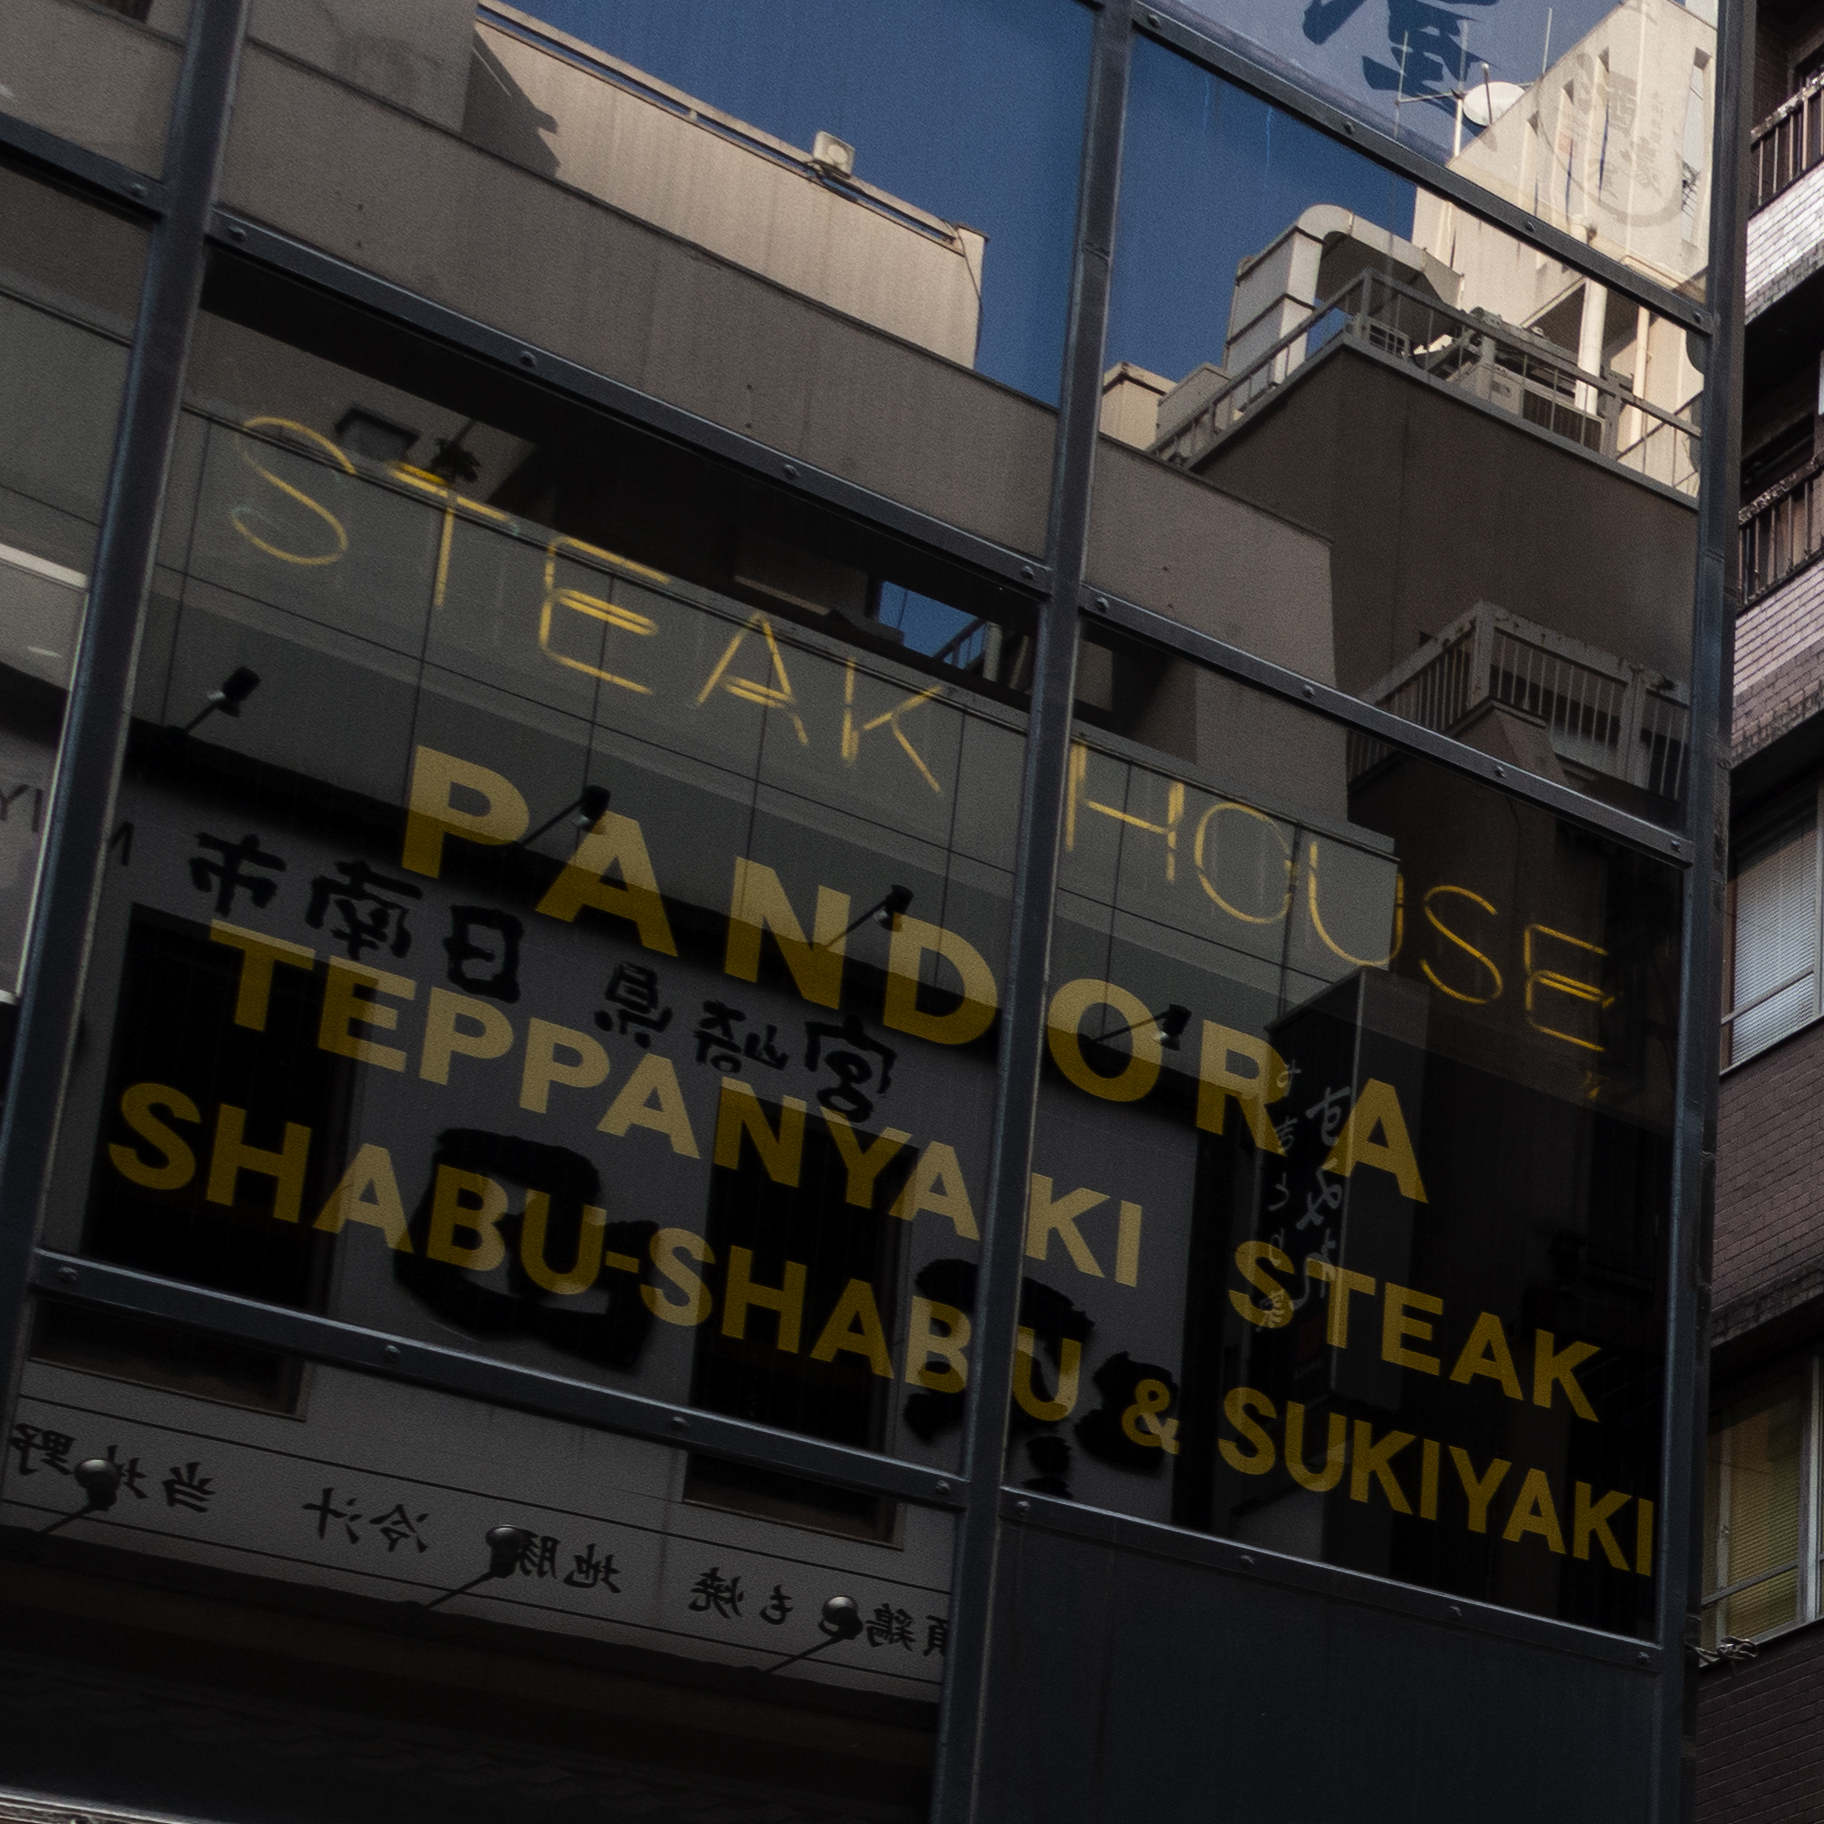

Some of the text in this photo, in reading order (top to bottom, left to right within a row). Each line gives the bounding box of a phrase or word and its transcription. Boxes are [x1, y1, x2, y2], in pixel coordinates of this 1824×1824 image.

[231, 416, 1614, 1052] STEAK HOUSE
[210, 919, 1143, 1288] TEPPANYAKI
[400, 744, 1429, 1204] PANDORA
[107, 1082, 1082, 1422] SHABU-SHABU
[1120, 1378, 1180, 1456] &
[1217, 1387, 1654, 1577] SUKIYAKI
[1227, 1240, 1602, 1424] STEAK
